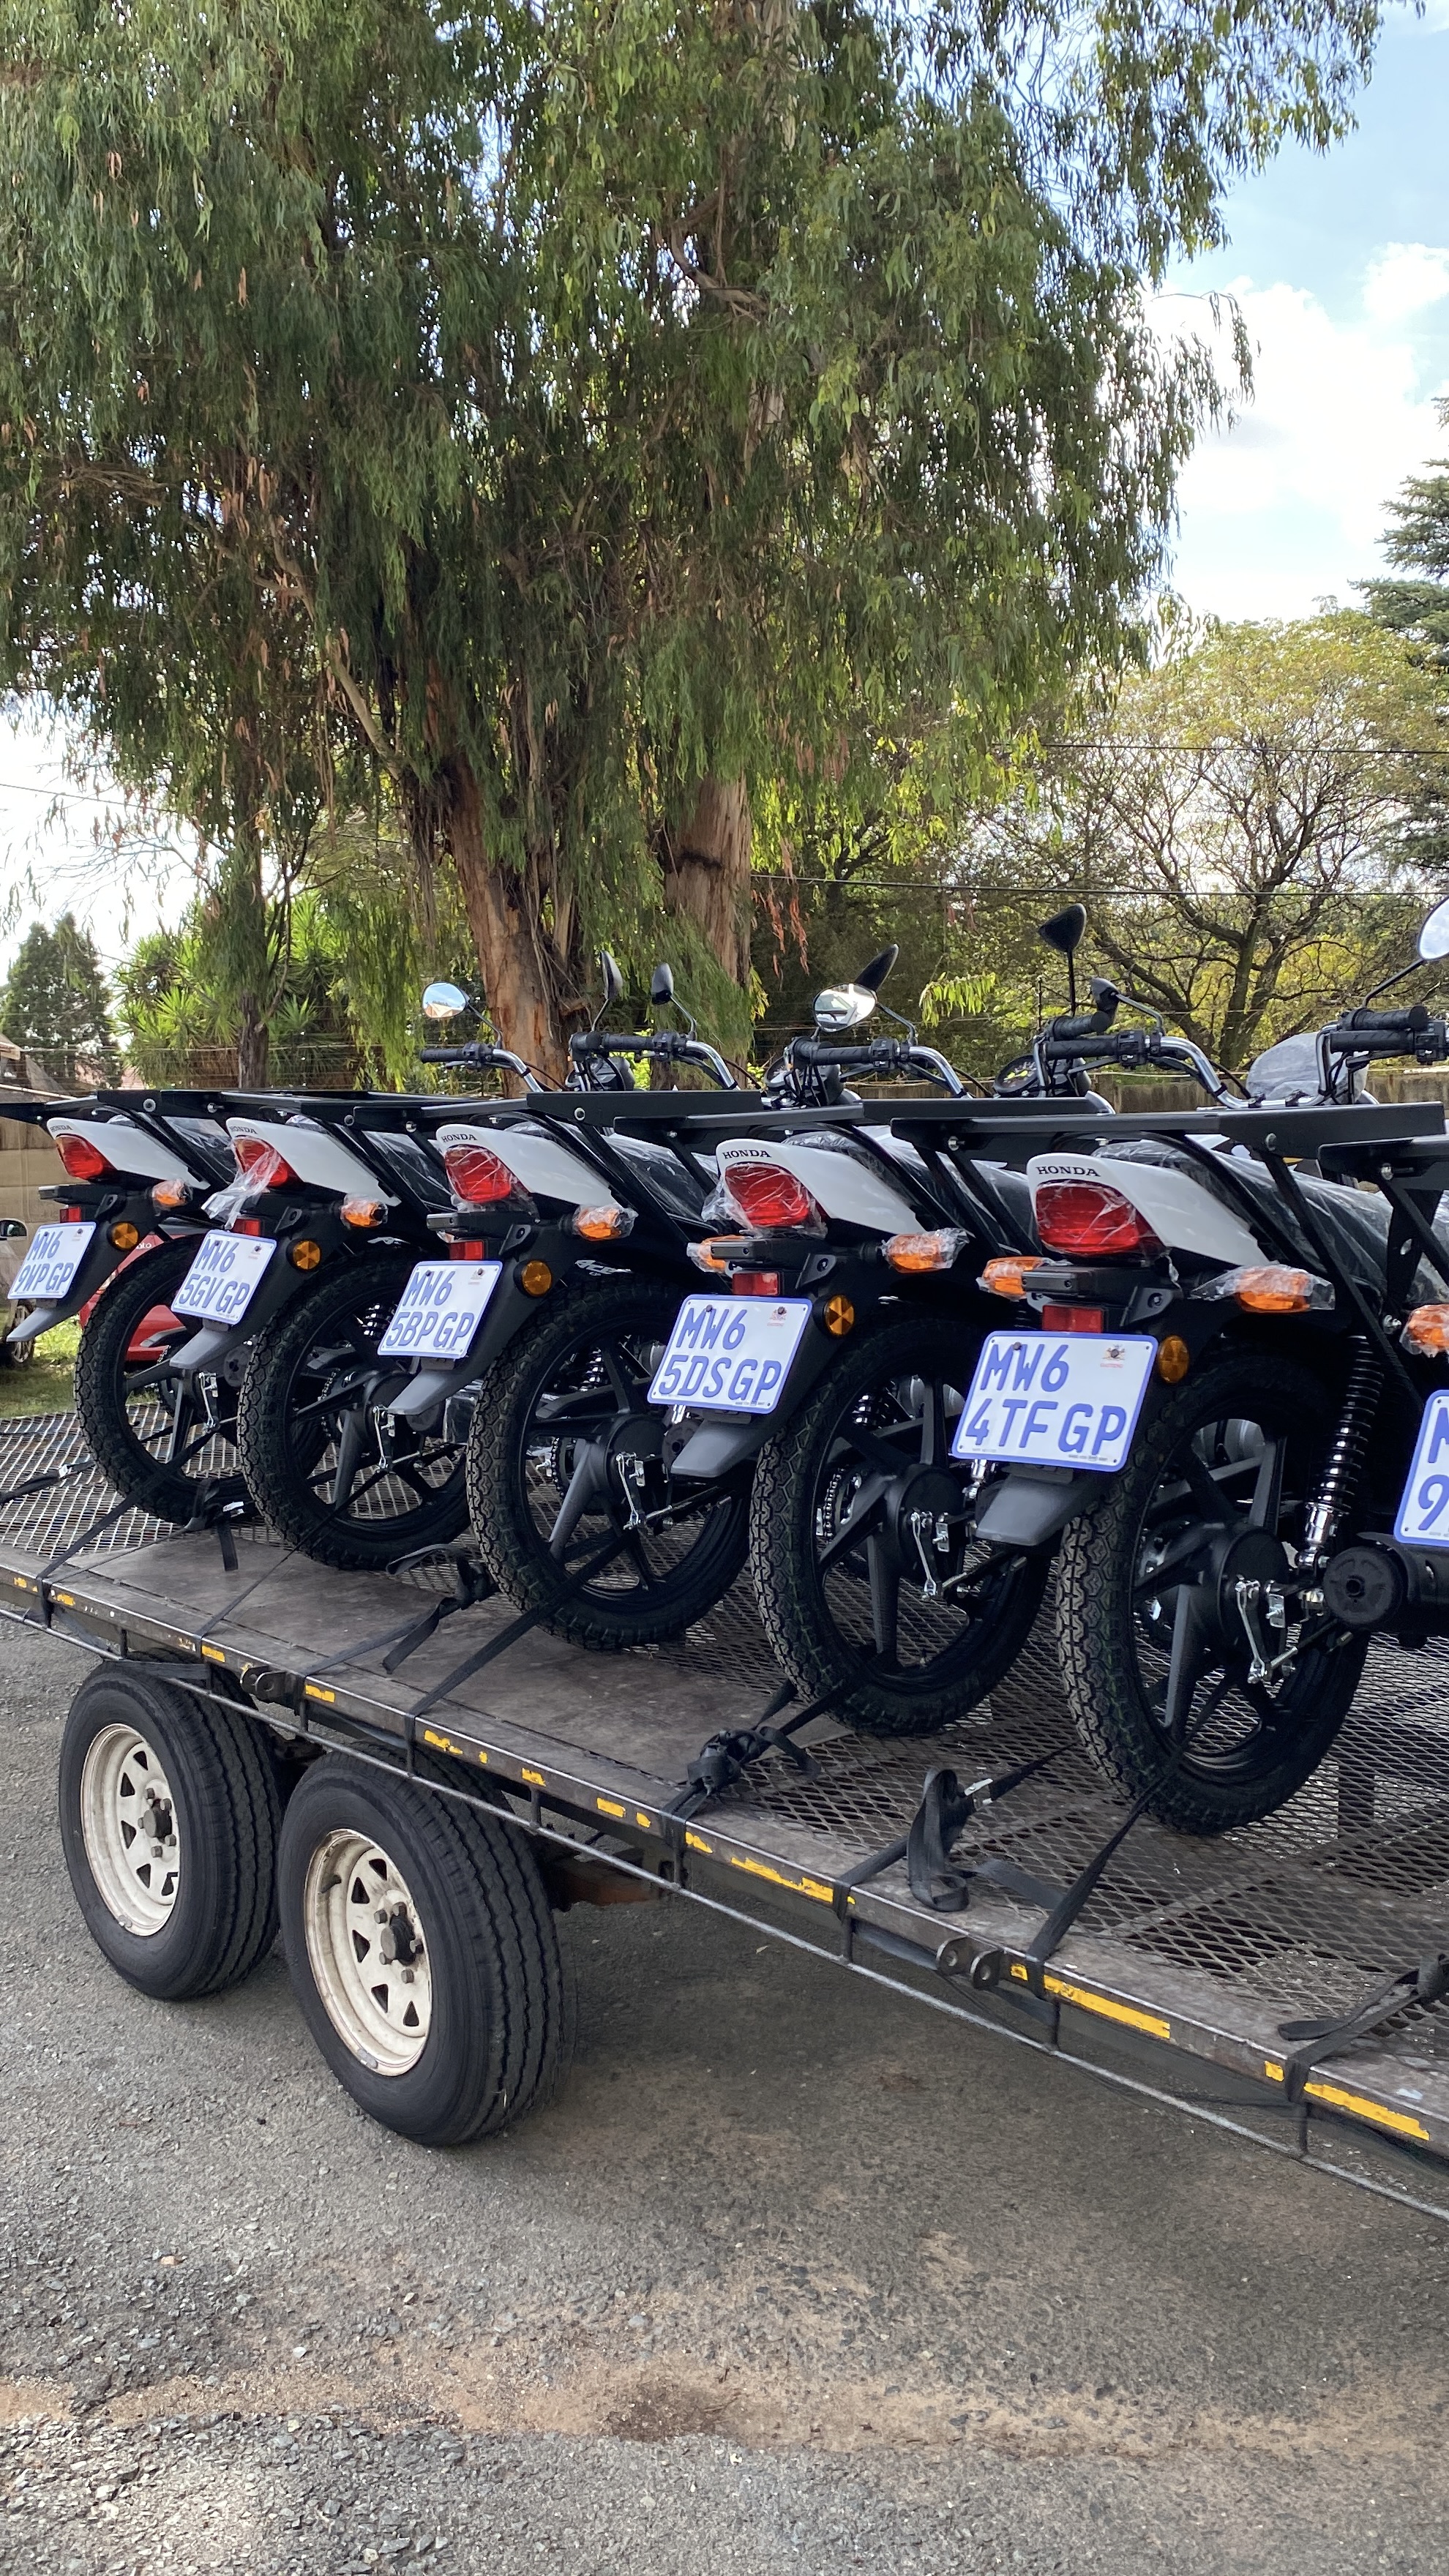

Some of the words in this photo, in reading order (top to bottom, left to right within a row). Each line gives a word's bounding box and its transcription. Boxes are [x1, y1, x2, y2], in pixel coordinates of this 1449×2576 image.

[229, 1126, 258, 1134] HONDA
[441, 1134, 478, 1142] HONDA
[722, 1150, 772, 1159] HONDA
[1036, 1166, 1101, 1177] HONDA
[27, 1231, 64, 1261] MW6
[195, 1238, 239, 1273] MW6
[402, 1270, 456, 1306] MW6
[675, 1307, 747, 1349] MW6
[980, 1344, 1069, 1392] MW6
